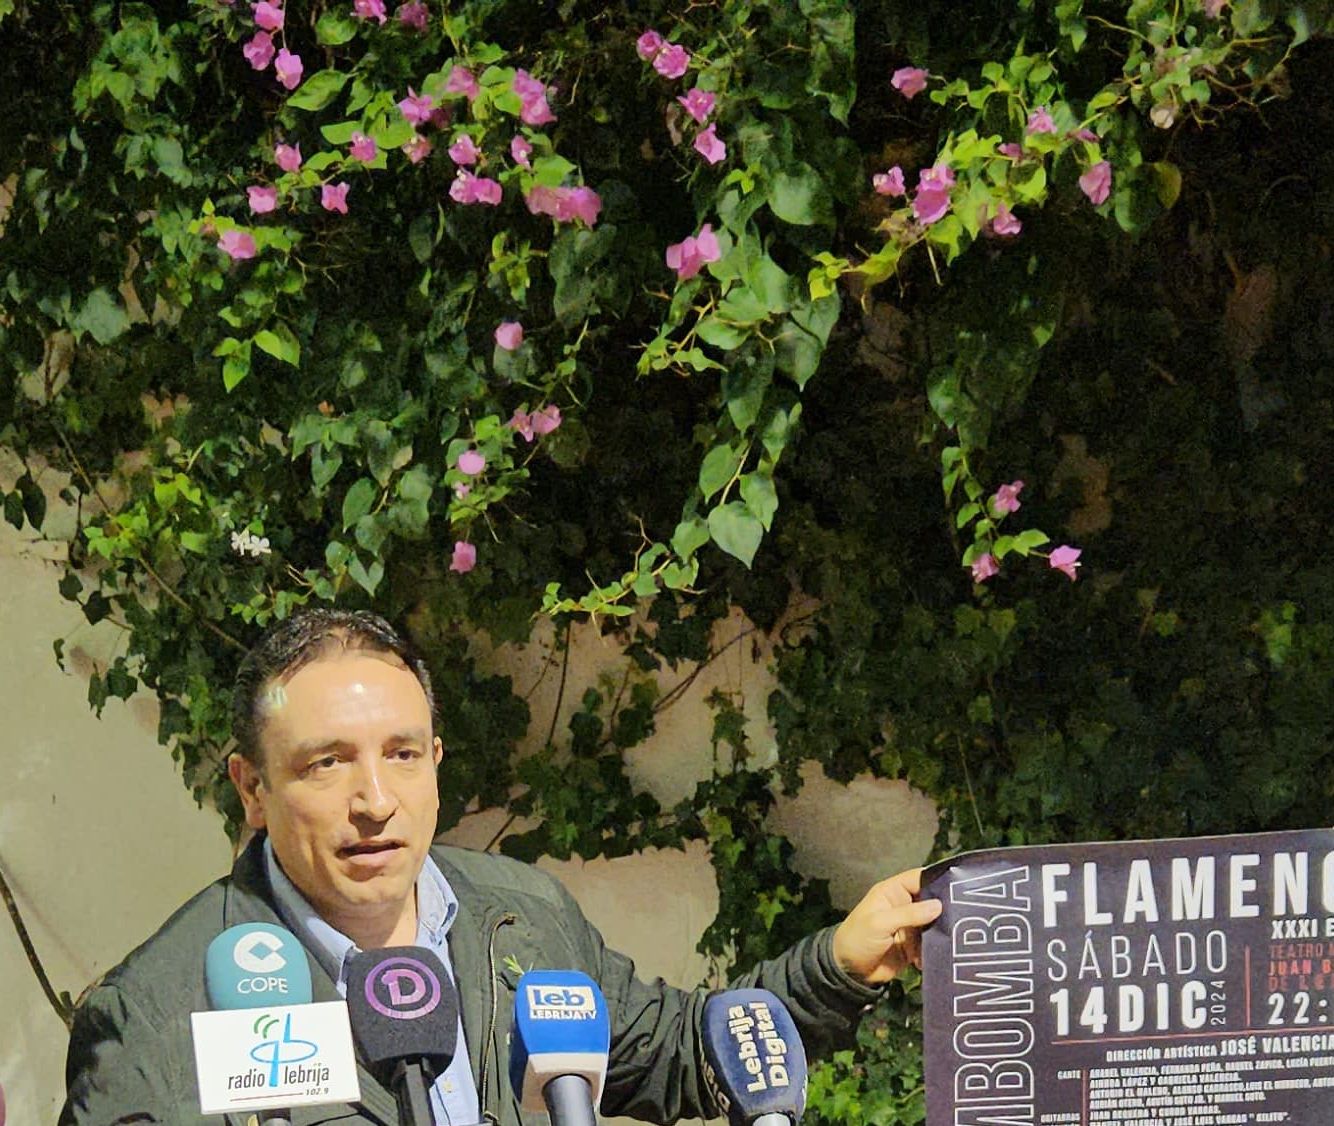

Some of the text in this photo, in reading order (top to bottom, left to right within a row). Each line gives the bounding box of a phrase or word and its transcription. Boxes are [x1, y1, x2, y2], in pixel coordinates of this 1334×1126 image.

[1271, 919, 1318, 940] XXXI
[1047, 929, 1227, 981] SÁBADO
[1269, 943, 1323, 959] TEATRO
[1269, 959, 1312, 976] JUAN
[237, 977, 289, 994] COPE
[1269, 976, 1288, 992] DE
[1211, 980, 1226, 1026] 2024
[728, 1005, 767, 1093] Lebrija
[748, 1001, 789, 1087] Digital
[1106, 1047, 1161, 1063] DIRECCIÓN
[1164, 1044, 1217, 1059] ARTÍSTICA
[1220, 1035, 1257, 1056] JOSÉ
[228, 1063, 330, 1090] radio lebrija
[306, 1088, 330, 1096] 102.9
